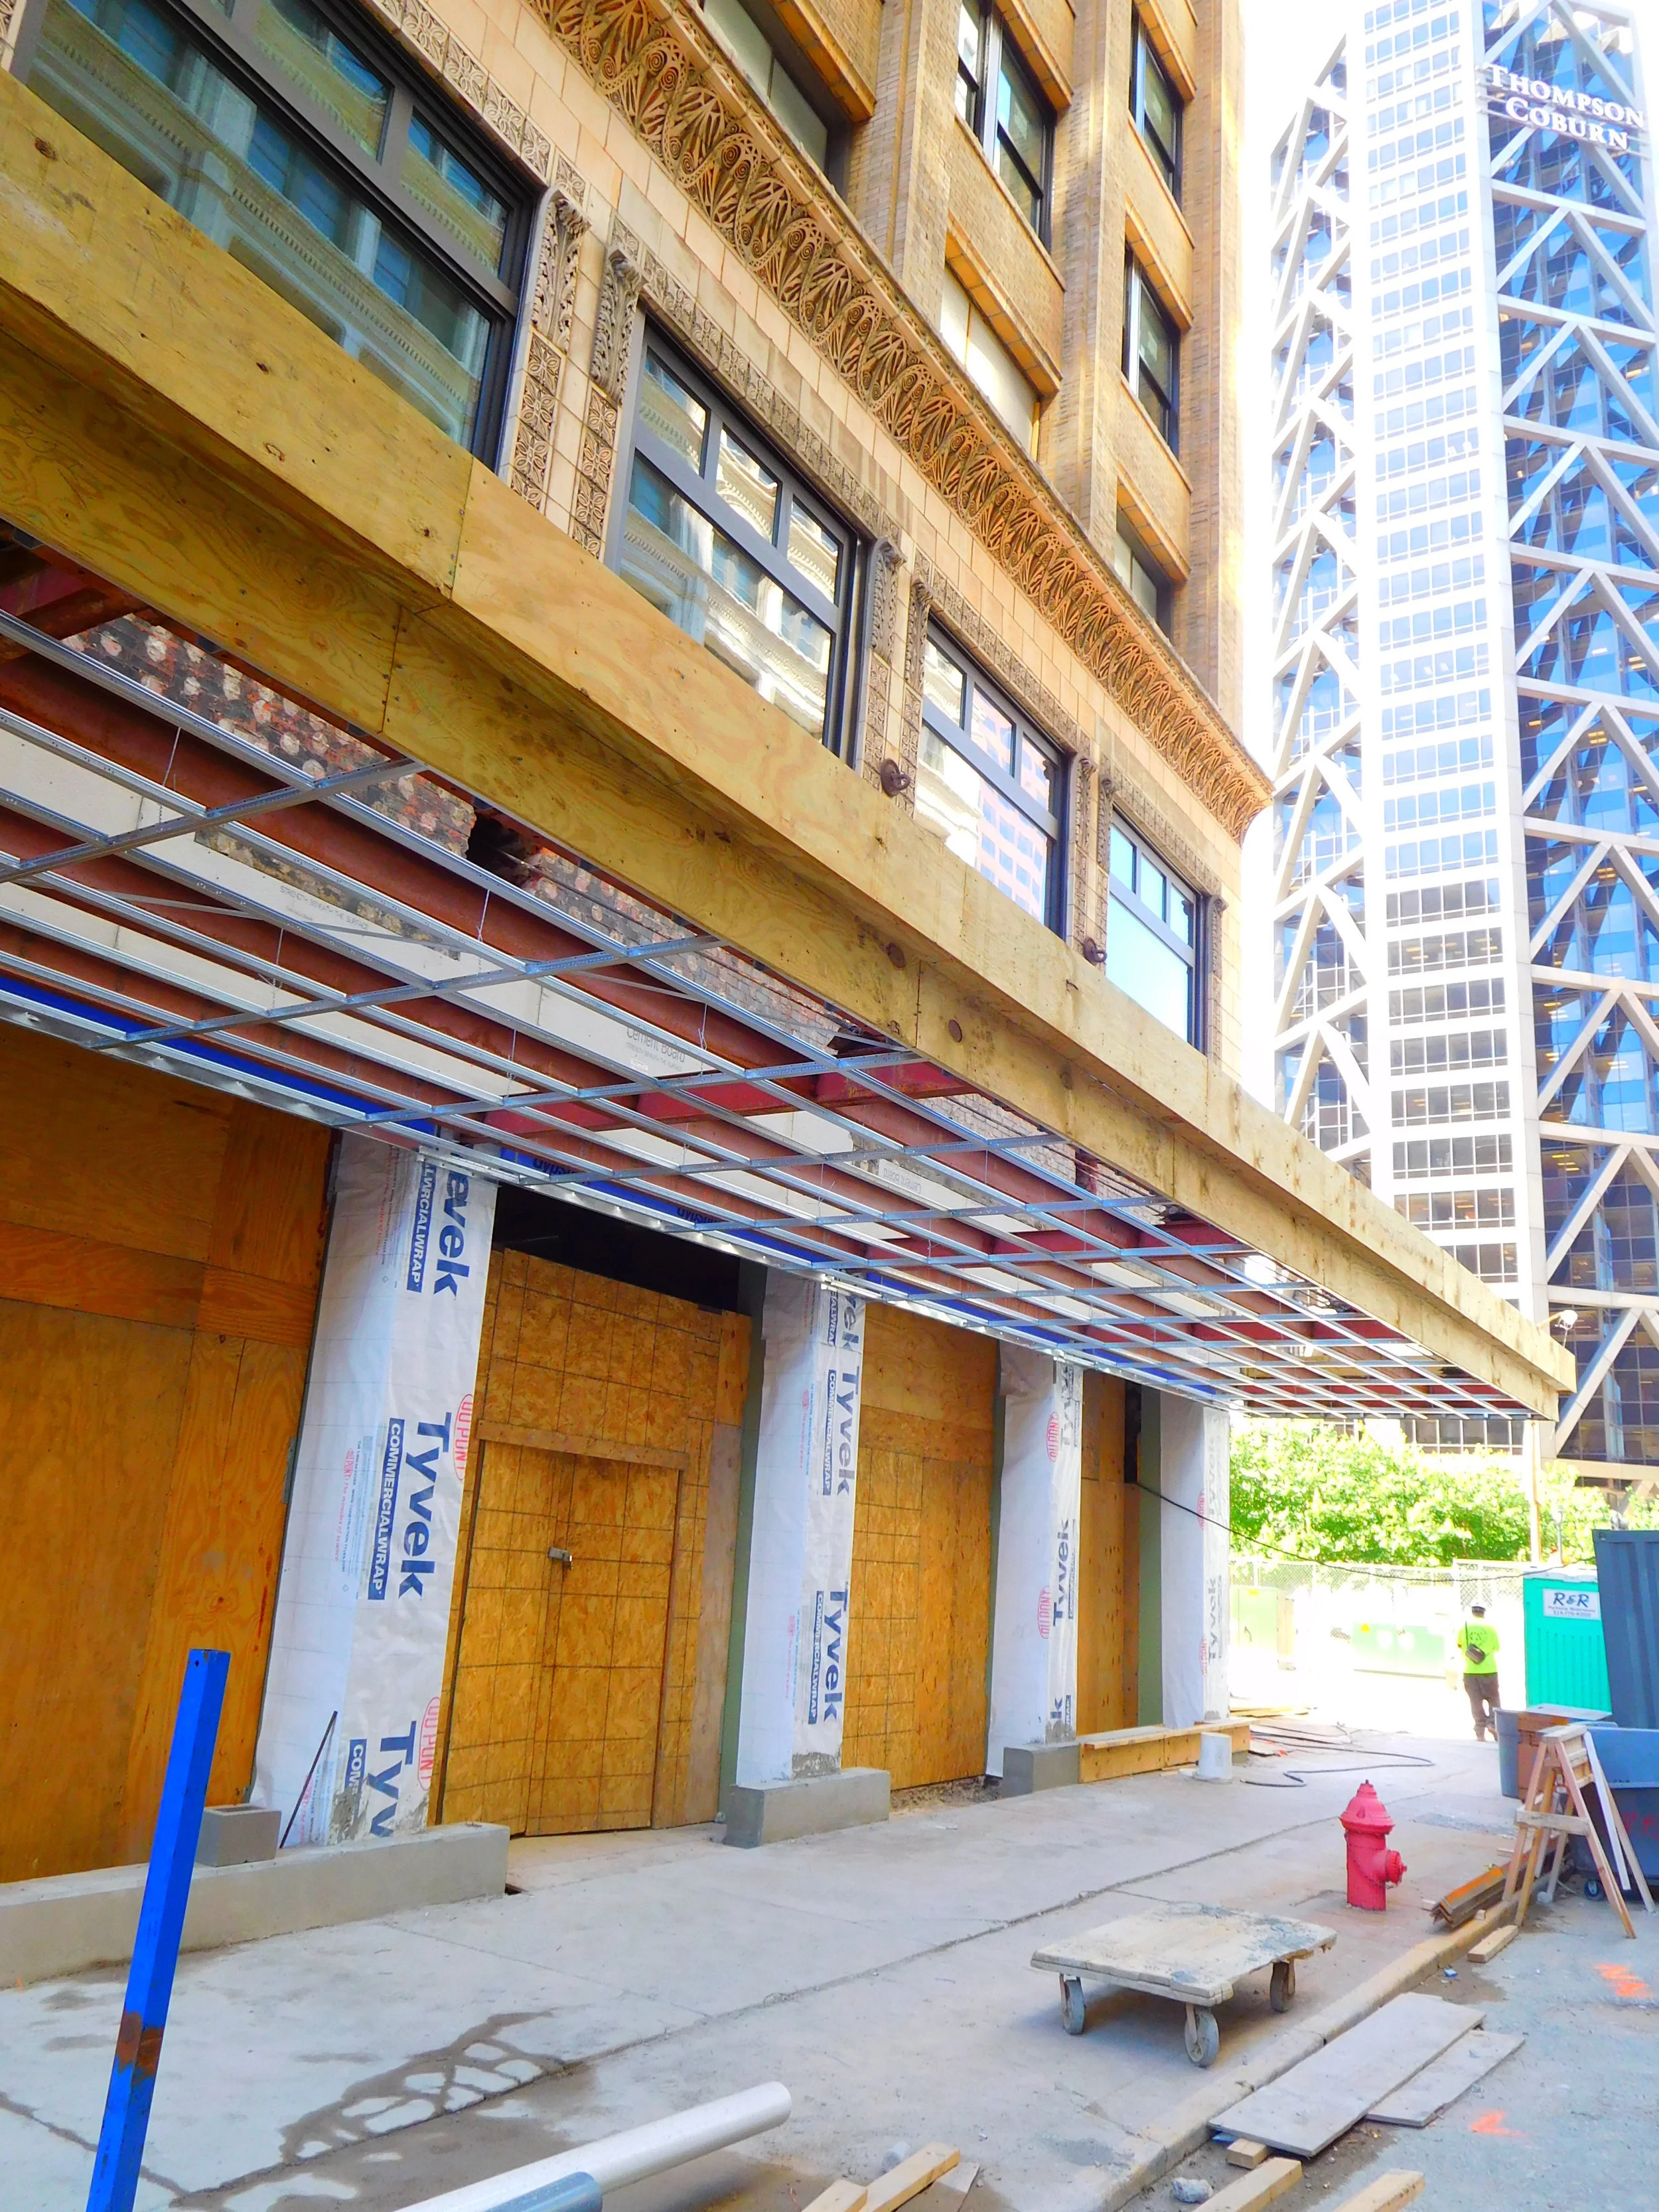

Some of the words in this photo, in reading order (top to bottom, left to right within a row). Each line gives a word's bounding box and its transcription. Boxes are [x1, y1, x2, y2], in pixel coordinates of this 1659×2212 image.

[1485, 62, 1644, 128] THOMPSON
[1506, 96, 1628, 150] COBURN
[626, 1027, 659, 1052] Cement
[661, 1044, 685, 1063] Board
[824, 1372, 836, 1489] COMMERCIALWRAP
[837, 1366, 859, 1496] Tyvek
[372, 1423, 401, 1591] COMMERCIALWRAP
[398, 1412, 452, 1599] Tyvek
[1052, 1519, 1068, 1627] Tyvek
[1553, 1592, 1589, 1608] R&R
[810, 1594, 824, 1718] COMMERCIALWRAP
[824, 1582, 848, 1722] Tyvek
